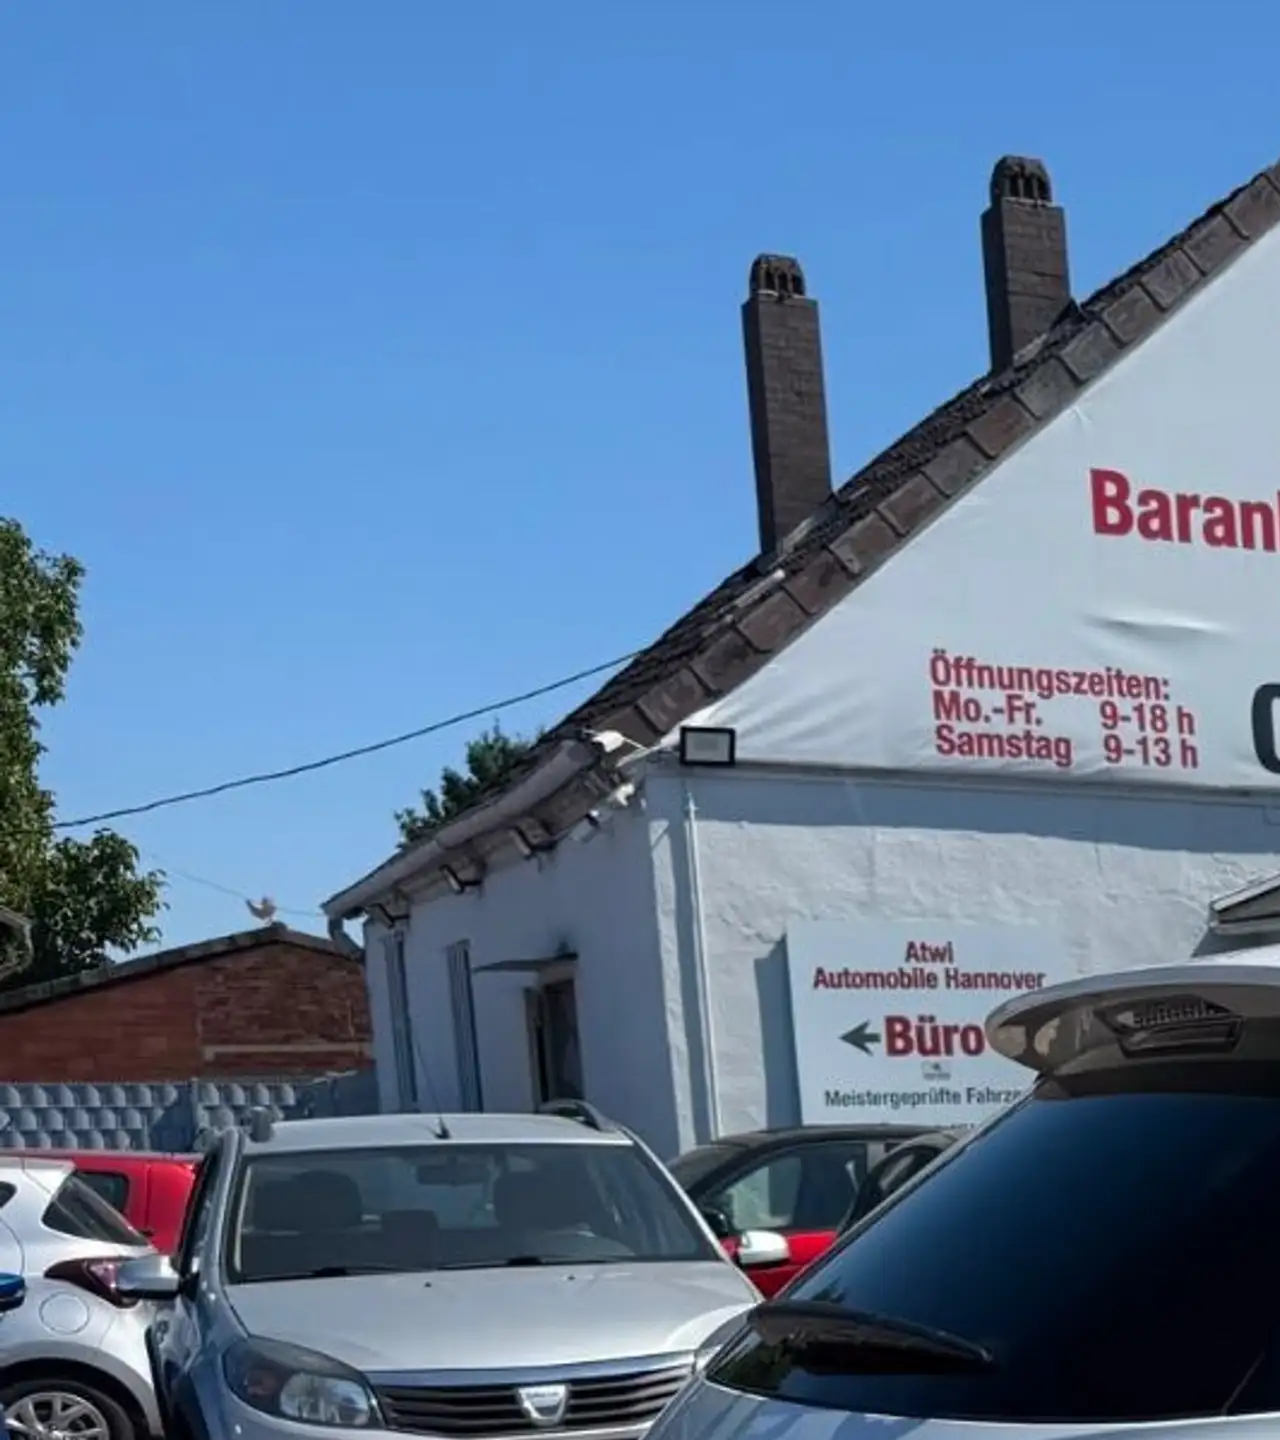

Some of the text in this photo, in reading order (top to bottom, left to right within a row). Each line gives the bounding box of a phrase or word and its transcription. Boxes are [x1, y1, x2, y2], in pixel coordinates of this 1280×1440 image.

[930, 648, 1170, 700] Öffnungszeiten:
[933, 690, 1195, 735] Mo.-Fr. 9-18 h
[935, 723, 1199, 768] Samstag 9-13 h
[905, 941, 953, 964] Atwi
[813, 967, 1046, 990] Automobile Hannover
[884, 1015, 986, 1057] Büro
[824, 1087, 962, 1109] Meistergeprüfte
